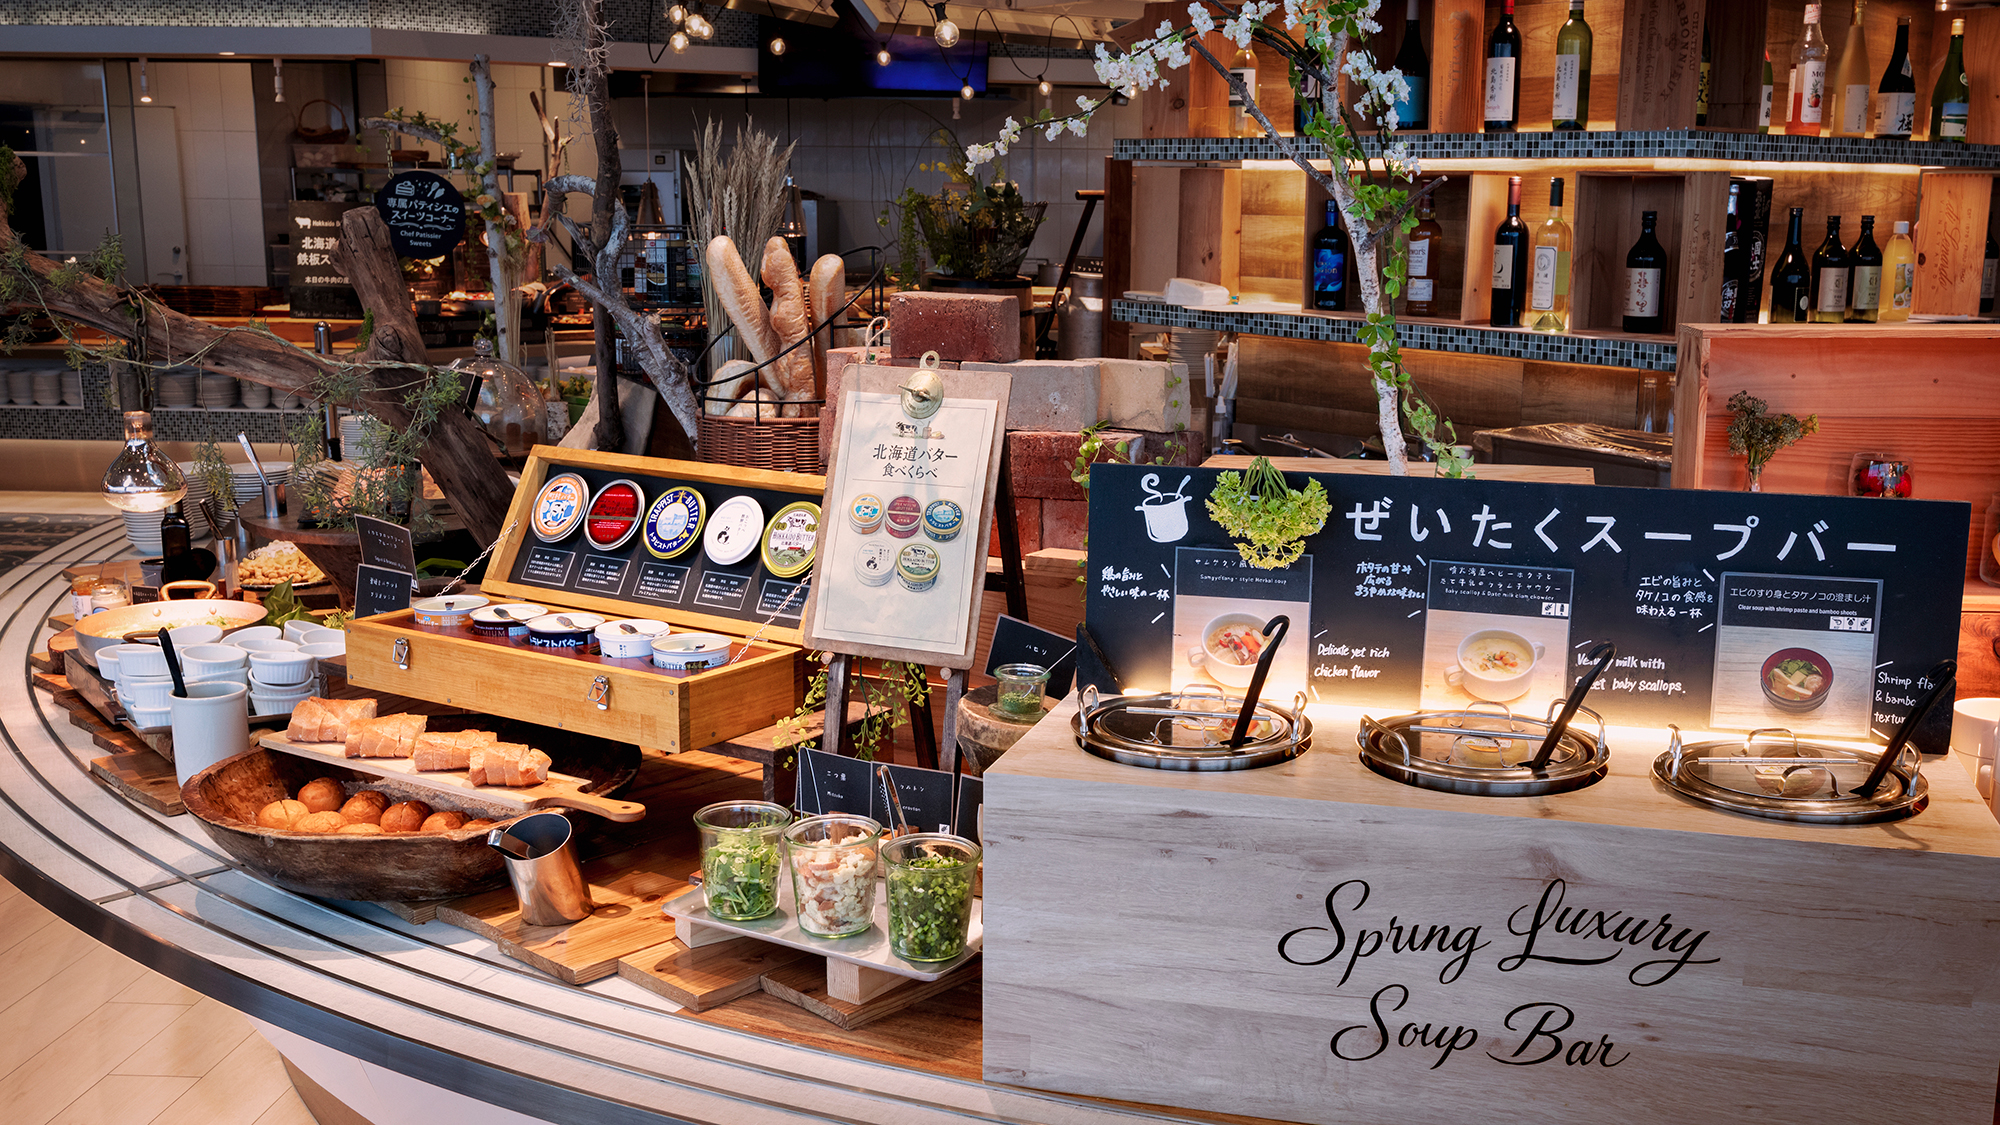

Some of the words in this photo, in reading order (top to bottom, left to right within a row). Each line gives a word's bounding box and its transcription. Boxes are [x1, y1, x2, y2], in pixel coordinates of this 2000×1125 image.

[387, 197, 459, 215] 専属パティシエの
[391, 210, 456, 224] スイーツコーナー
[400, 230, 414, 238] Chef
[415, 231, 442, 239] Patissier
[1688, 213, 1700, 299] LANESSAN
[872, 443, 958, 463] 北海道バター
[882, 462, 938, 479] 食べくらべ
[648, 493, 675, 523] TRAPPIST
[684, 495, 699, 530] BUTTER
[1345, 496, 1897, 562] ぜいたくスープバー
[648, 531, 683, 550] トラピストバター
[1101, 565, 1144, 582] 鶏の旨みと
[1356, 561, 1412, 575] ホタテの甘み
[1363, 573, 1392, 586] 広がる
[1639, 575, 1702, 588] エビの旨みと
[1100, 584, 1170, 601] やさしい味の一杯
[1354, 584, 1425, 600] まろやかな味わい
[1635, 589, 1713, 603] タケノコの食感を
[1730, 587, 1871, 603] エビのすり身とタケノコの澄まし汁
[1636, 604, 1703, 619] 味わえる一杯
[1317, 643, 1350, 656] Delicate
[1350, 647, 1367, 660] yet
[1369, 647, 1390, 658] rich
[1314, 663, 1348, 677] chicken
[1350, 664, 1381, 679] flavor
[1615, 656, 1638, 668] milk
[1640, 657, 1666, 670] with
[1612, 677, 1637, 692] baby
[1878, 671, 1912, 690] Shrimp
[1875, 689, 1882, 702] &
[1277, 879, 1492, 988] Spring
[1497, 877, 1722, 987] Luxury
[1329, 982, 1479, 1071] Soup
[1486, 1001, 1631, 1069] Bar
